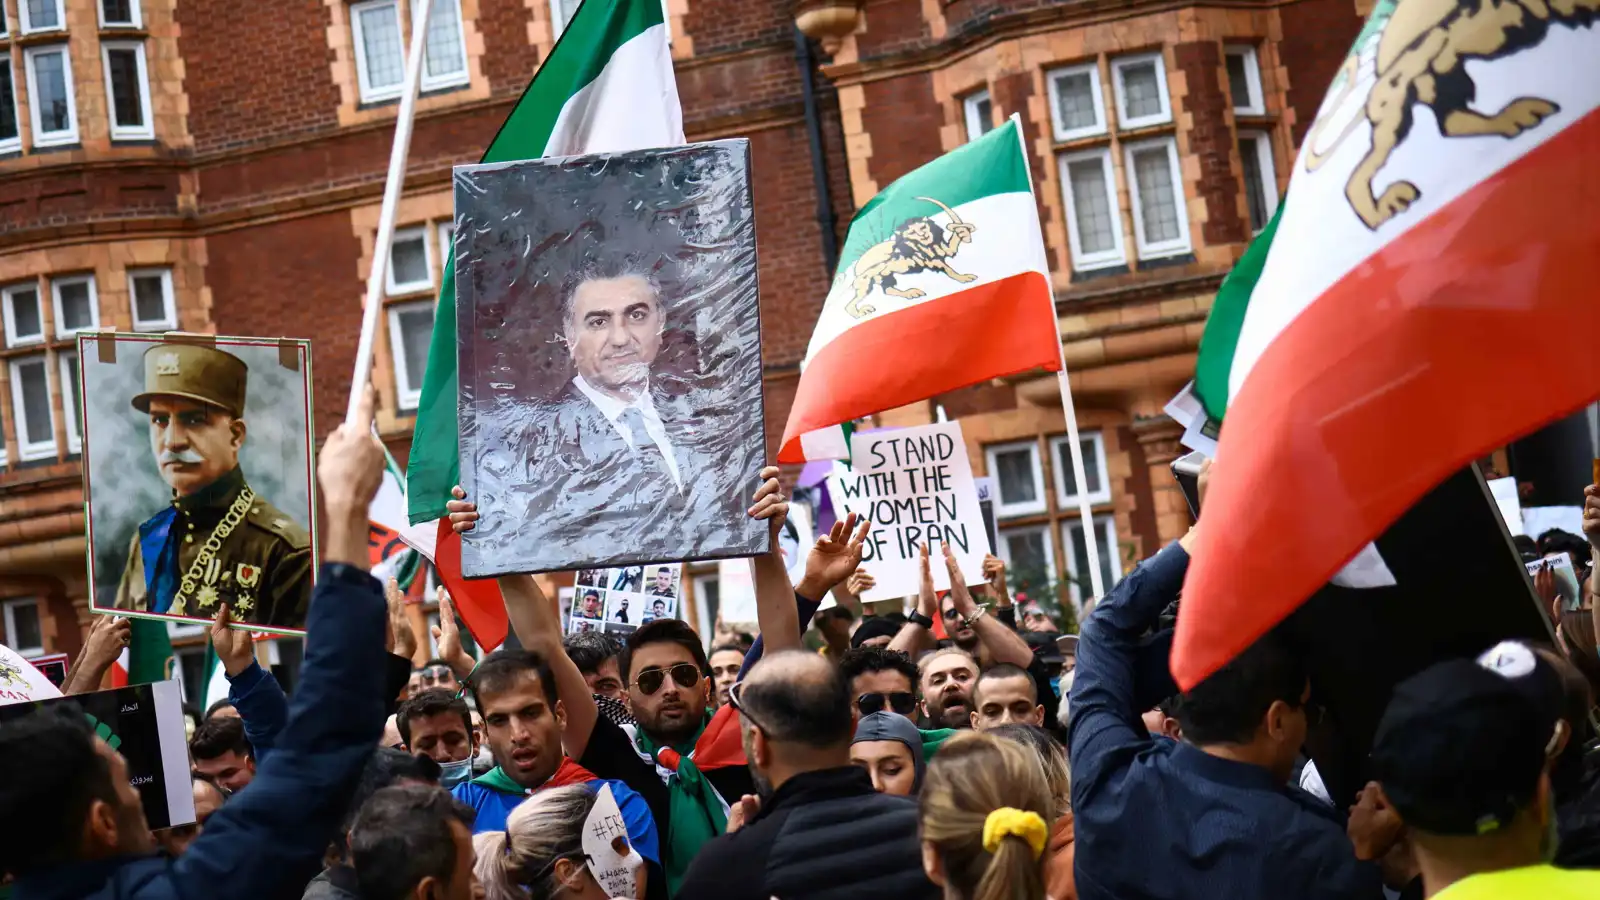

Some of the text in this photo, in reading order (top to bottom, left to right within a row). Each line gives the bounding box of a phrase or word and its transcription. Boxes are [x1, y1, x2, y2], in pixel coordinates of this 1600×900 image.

[870, 432, 954, 469] STAND
[840, 470, 897, 498] WITH
[903, 464, 952, 494] THE
[844, 493, 957, 526] WOMEN
[896, 523, 969, 559] IRAN
[120, 702, 139, 713] اتحاد
